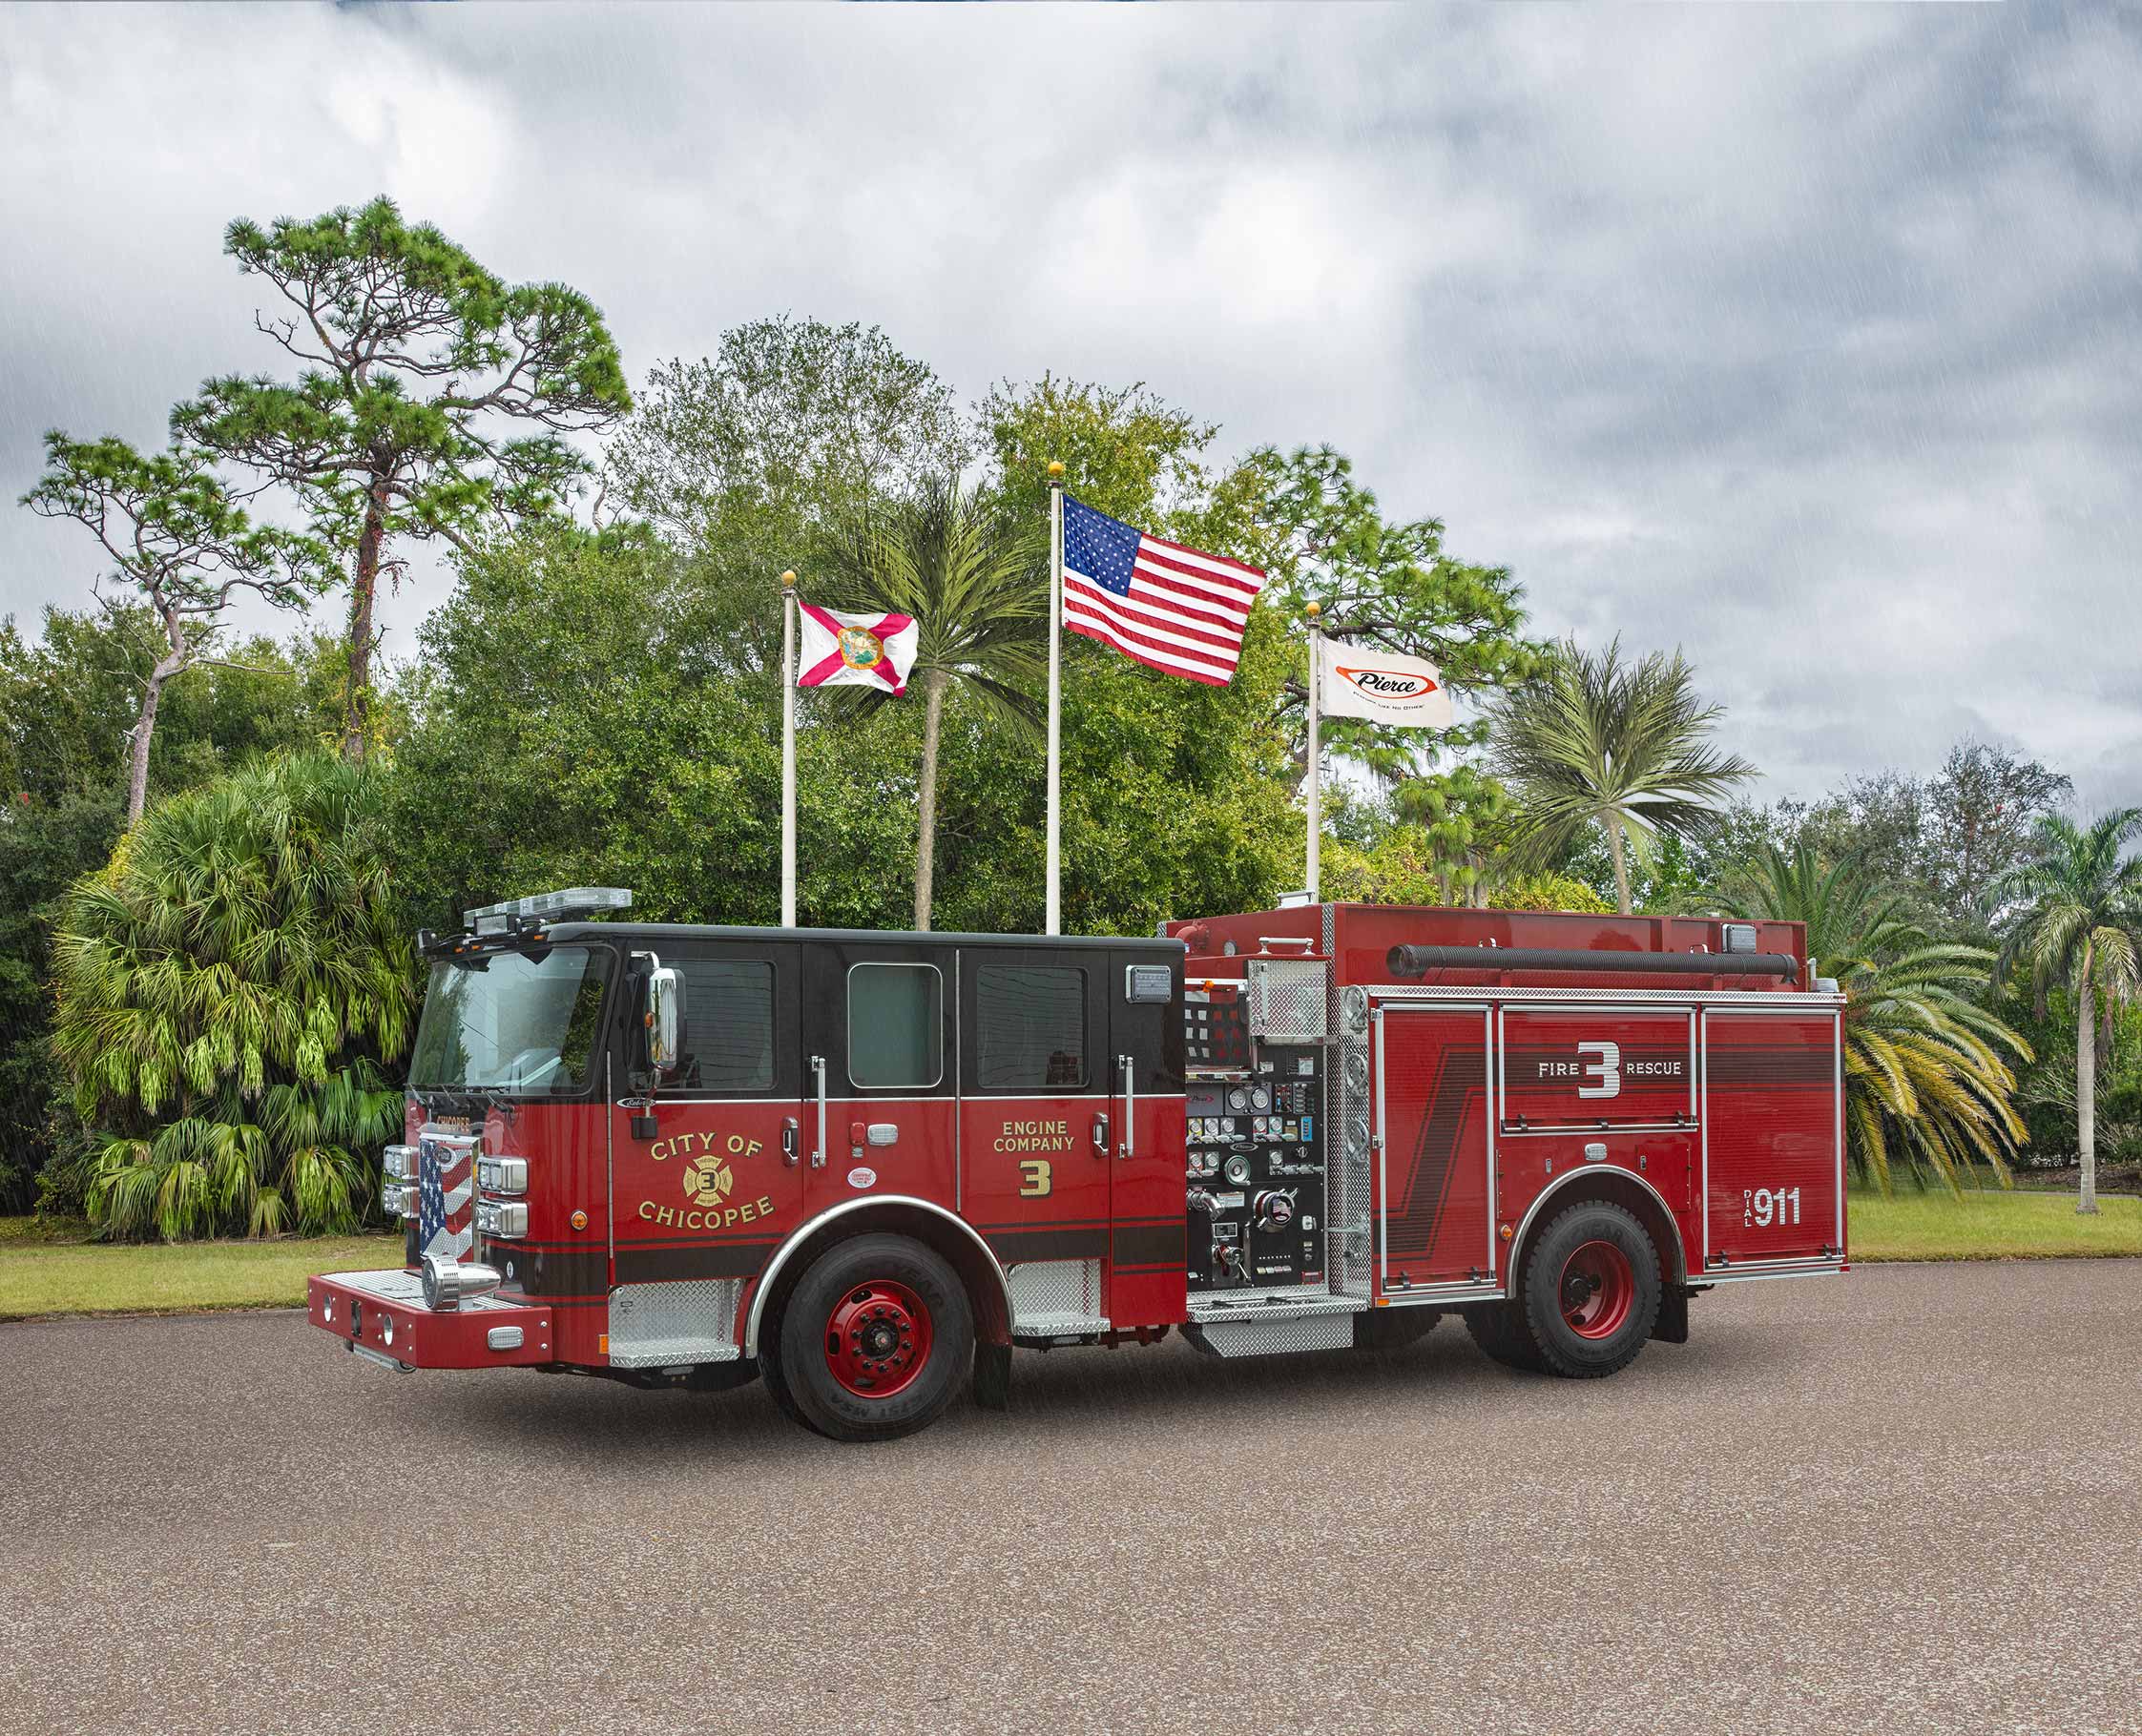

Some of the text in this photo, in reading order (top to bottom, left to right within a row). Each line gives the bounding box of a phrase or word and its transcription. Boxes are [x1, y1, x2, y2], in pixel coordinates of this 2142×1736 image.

[1358, 672, 1416, 692] Pierce
[1538, 1041, 1682, 1099] FIRE 3 RESCUE
[1002, 1121, 1068, 1136] ENGINE
[650, 1131, 763, 1161] CITY OF
[993, 1136, 1075, 1152] COMPANY
[700, 1171, 716, 1190] 3
[1019, 1159, 1052, 1197] 3
[638, 1195, 776, 1230] CHICOPEE
[1742, 1187, 1800, 1228] DIAL 911
